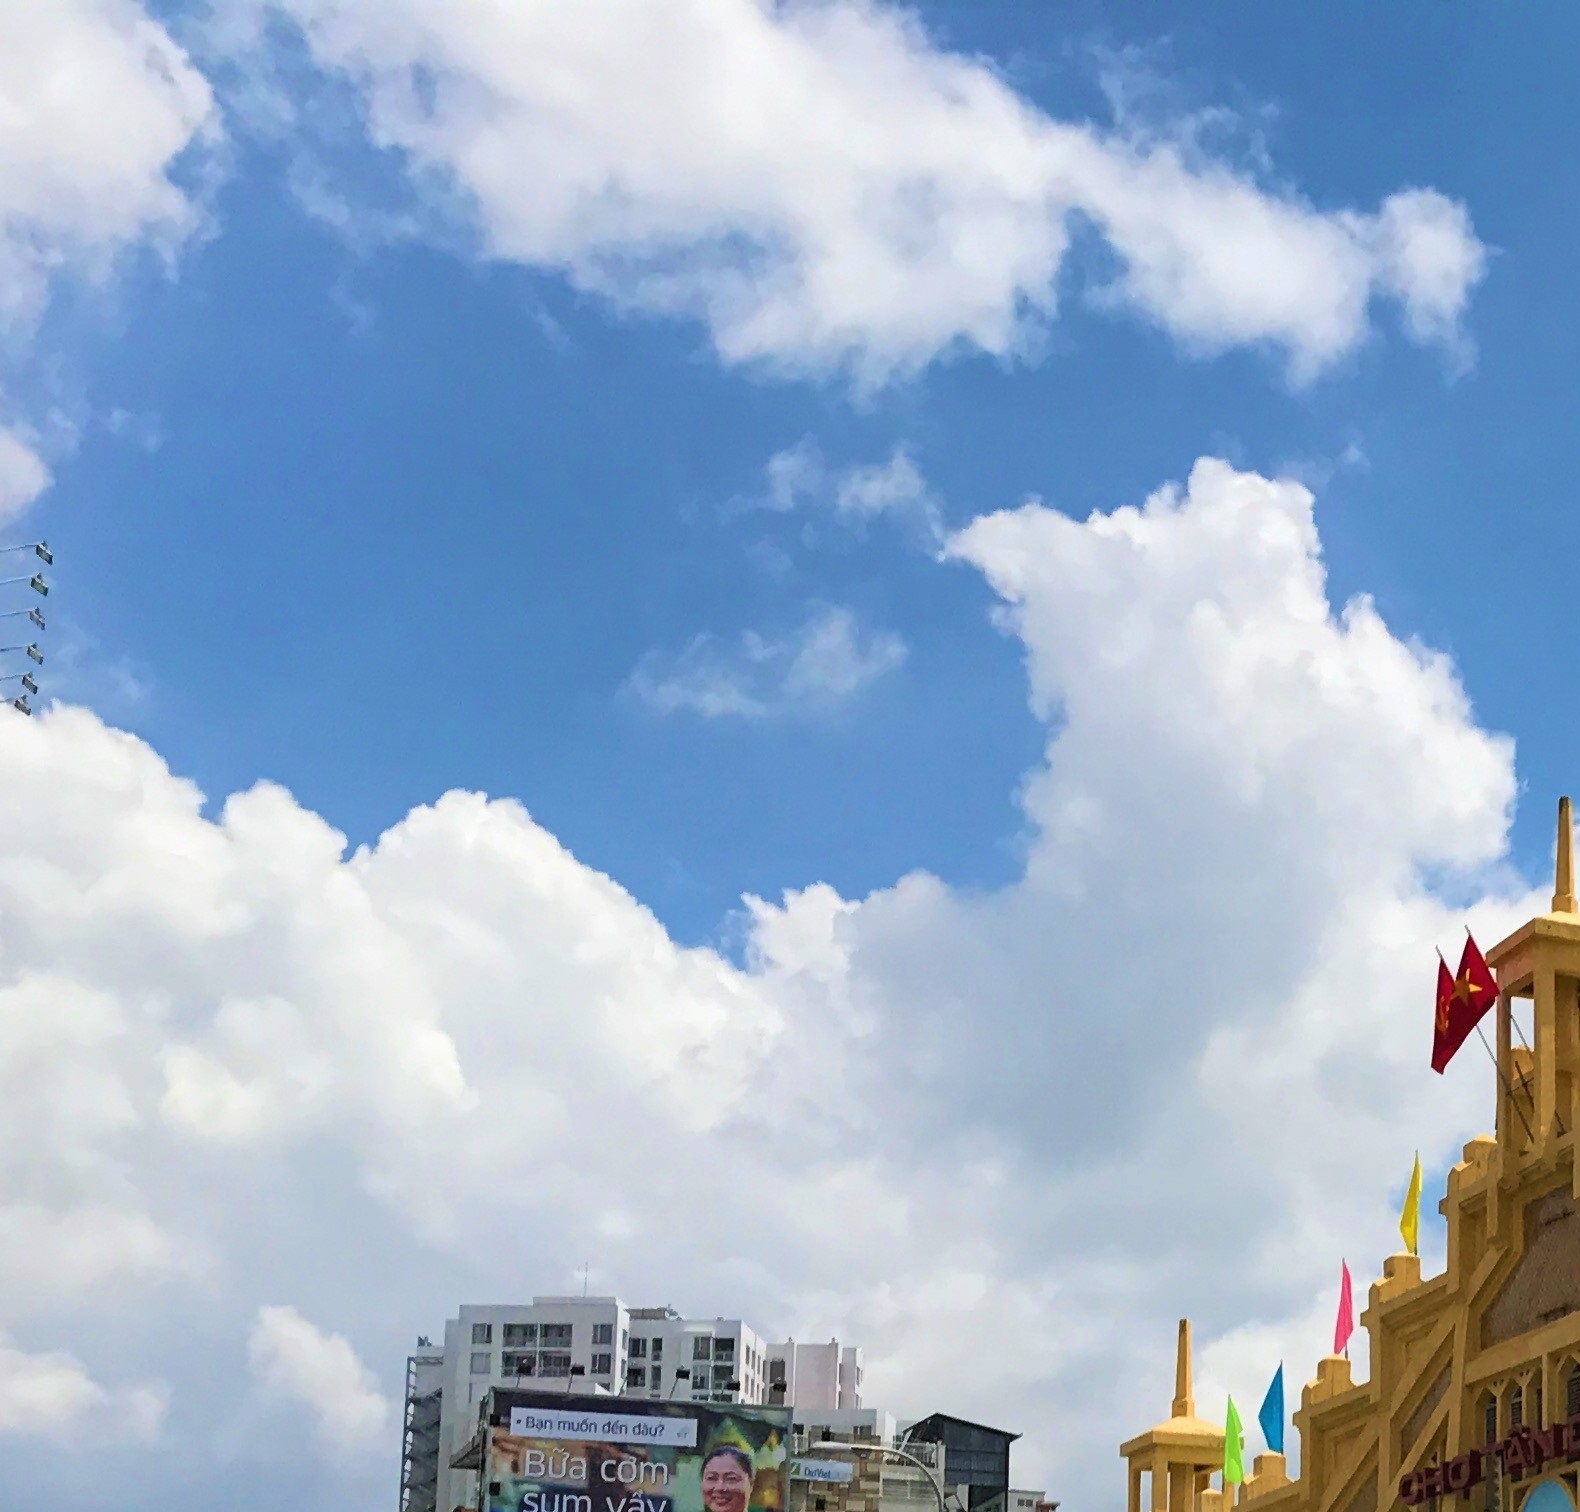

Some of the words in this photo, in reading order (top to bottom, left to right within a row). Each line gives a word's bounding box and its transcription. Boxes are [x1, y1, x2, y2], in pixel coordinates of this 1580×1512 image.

[525, 1416, 552, 1432] Bạn
[557, 1418, 597, 1434] muốn
[602, 1420, 627, 1435] đến
[632, 1423, 665, 1438] đâu?
[524, 1448, 587, 1481] Bữa
[600, 1456, 668, 1485] cơm
